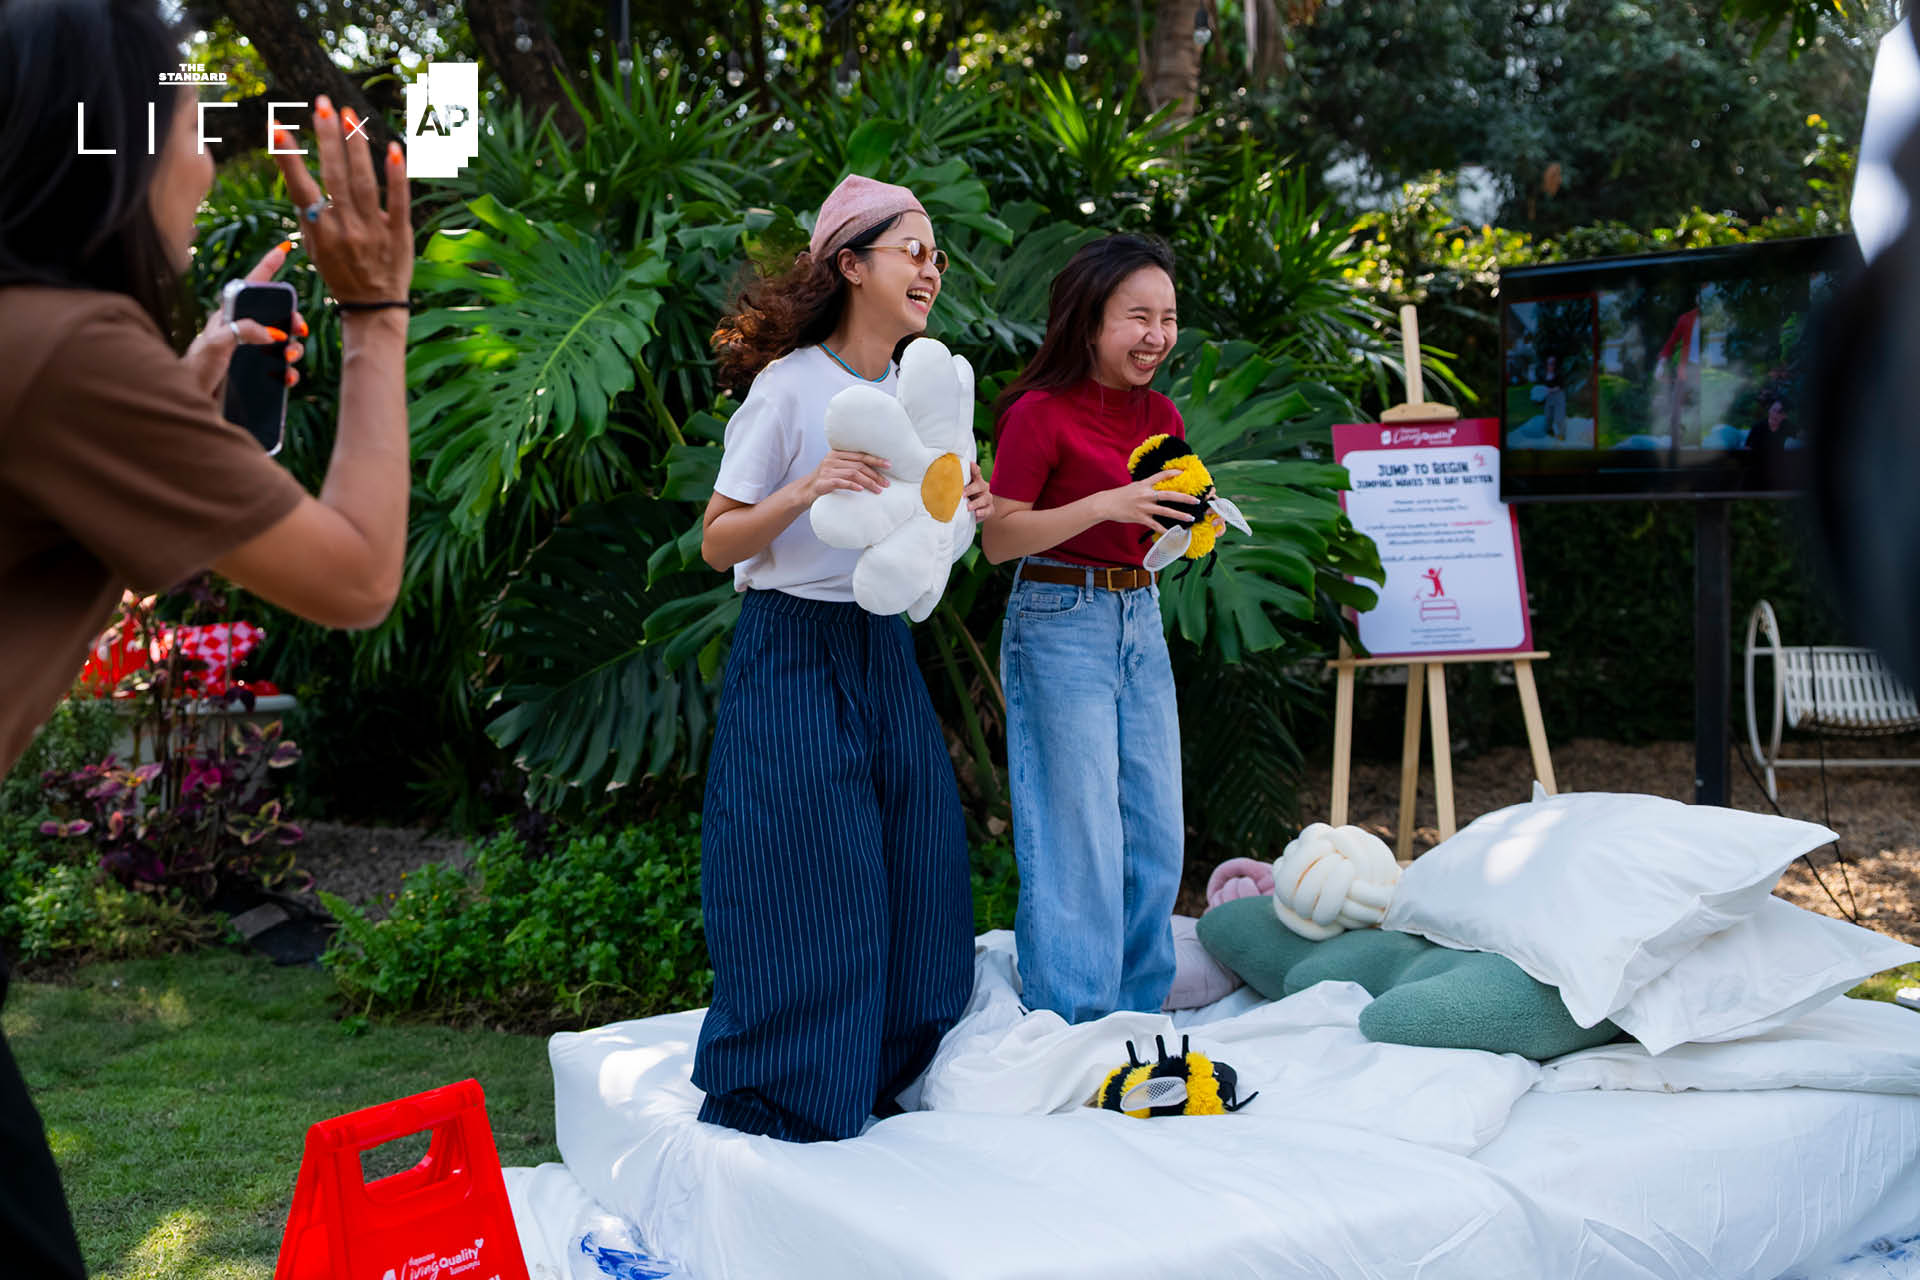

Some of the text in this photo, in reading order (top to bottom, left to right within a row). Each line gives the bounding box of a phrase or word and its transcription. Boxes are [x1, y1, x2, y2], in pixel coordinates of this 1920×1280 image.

[1378, 461, 1469, 477] JUMP TO BEGIN
[1356, 478, 1393, 489] JUMPING
[1426, 476, 1441, 486] THE
[1463, 474, 1493, 484] BETTER
[439, 1247, 479, 1269] Quality
